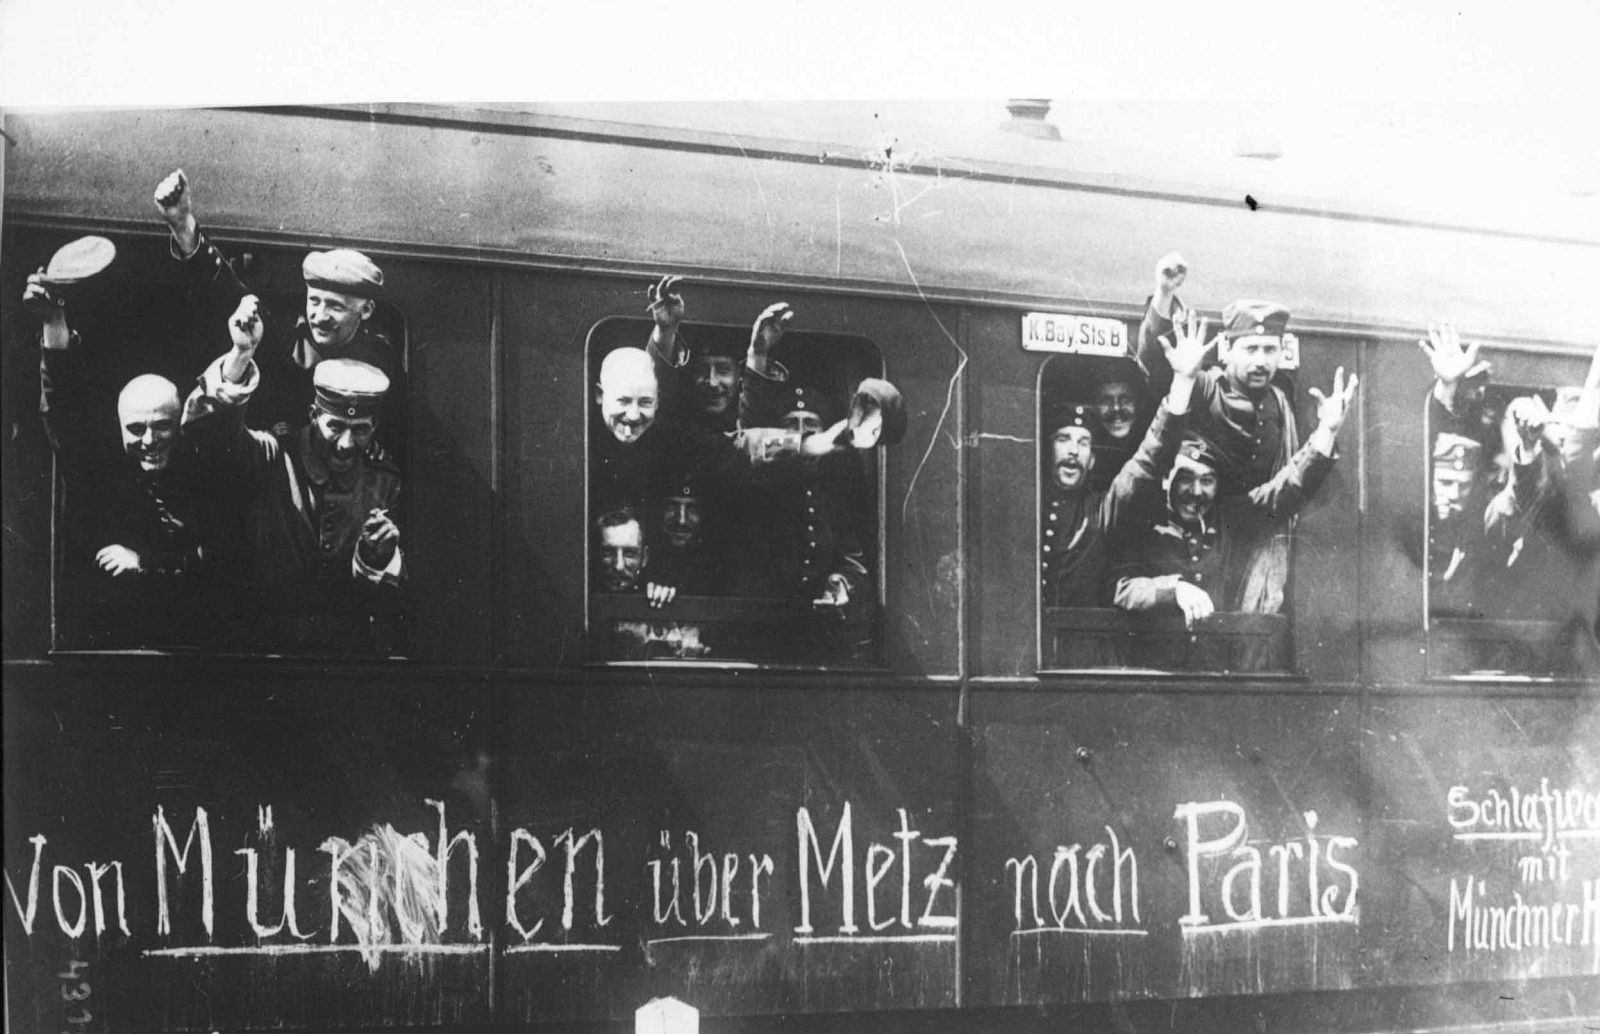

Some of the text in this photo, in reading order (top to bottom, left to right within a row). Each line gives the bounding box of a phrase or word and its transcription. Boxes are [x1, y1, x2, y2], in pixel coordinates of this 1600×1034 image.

[648, 830, 773, 926] über
[797, 802, 958, 935] Metz
[1006, 826, 1140, 931] nach
[1174, 801, 1359, 925] Paris
[1518, 842, 1571, 882] mit
